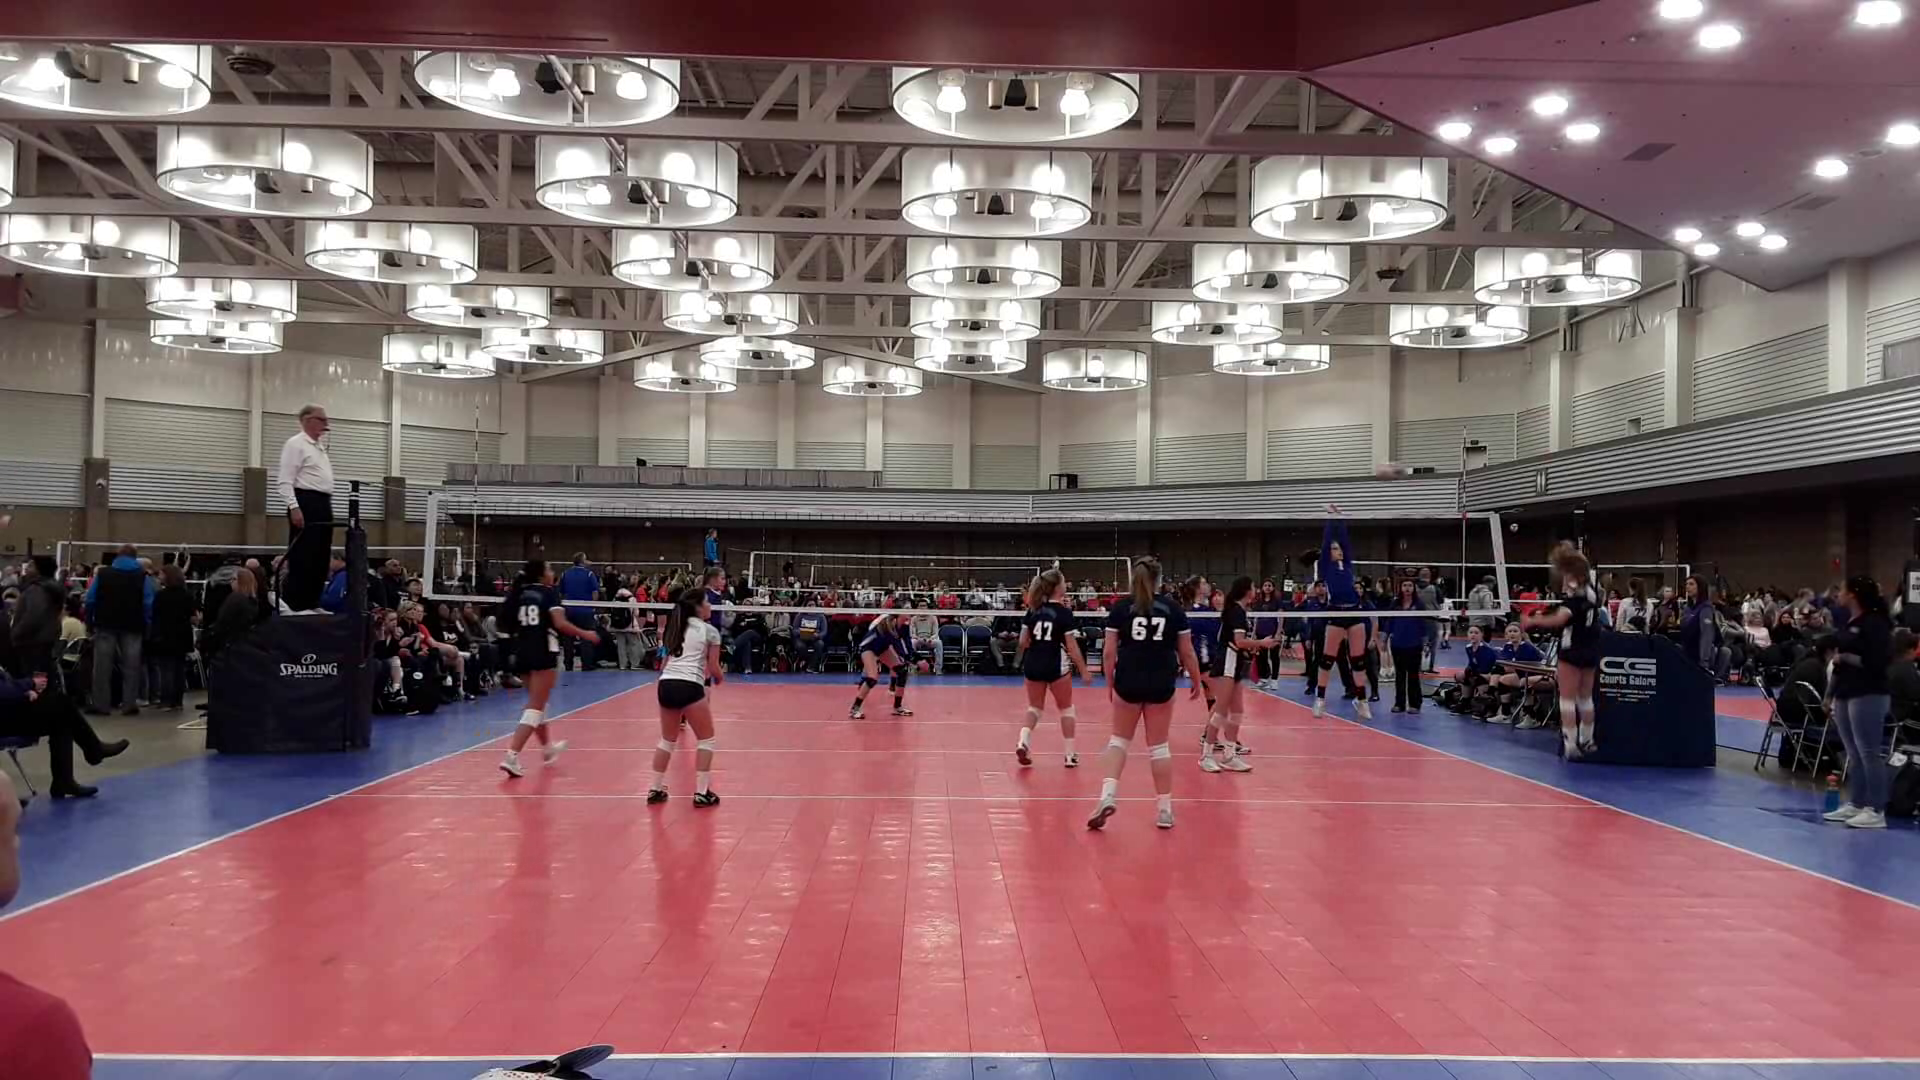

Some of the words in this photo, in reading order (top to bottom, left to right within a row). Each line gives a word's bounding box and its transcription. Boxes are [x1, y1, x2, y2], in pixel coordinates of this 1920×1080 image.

[518, 604, 540, 626] 48
[1033, 620, 1053, 641] 47
[1131, 616, 1167, 641] 67
[279, 662, 338, 676] SPALDING
[1600, 656, 1657, 676] CG
[1599, 673, 1627, 684] Courts
[1629, 675, 1657, 686] Galore
